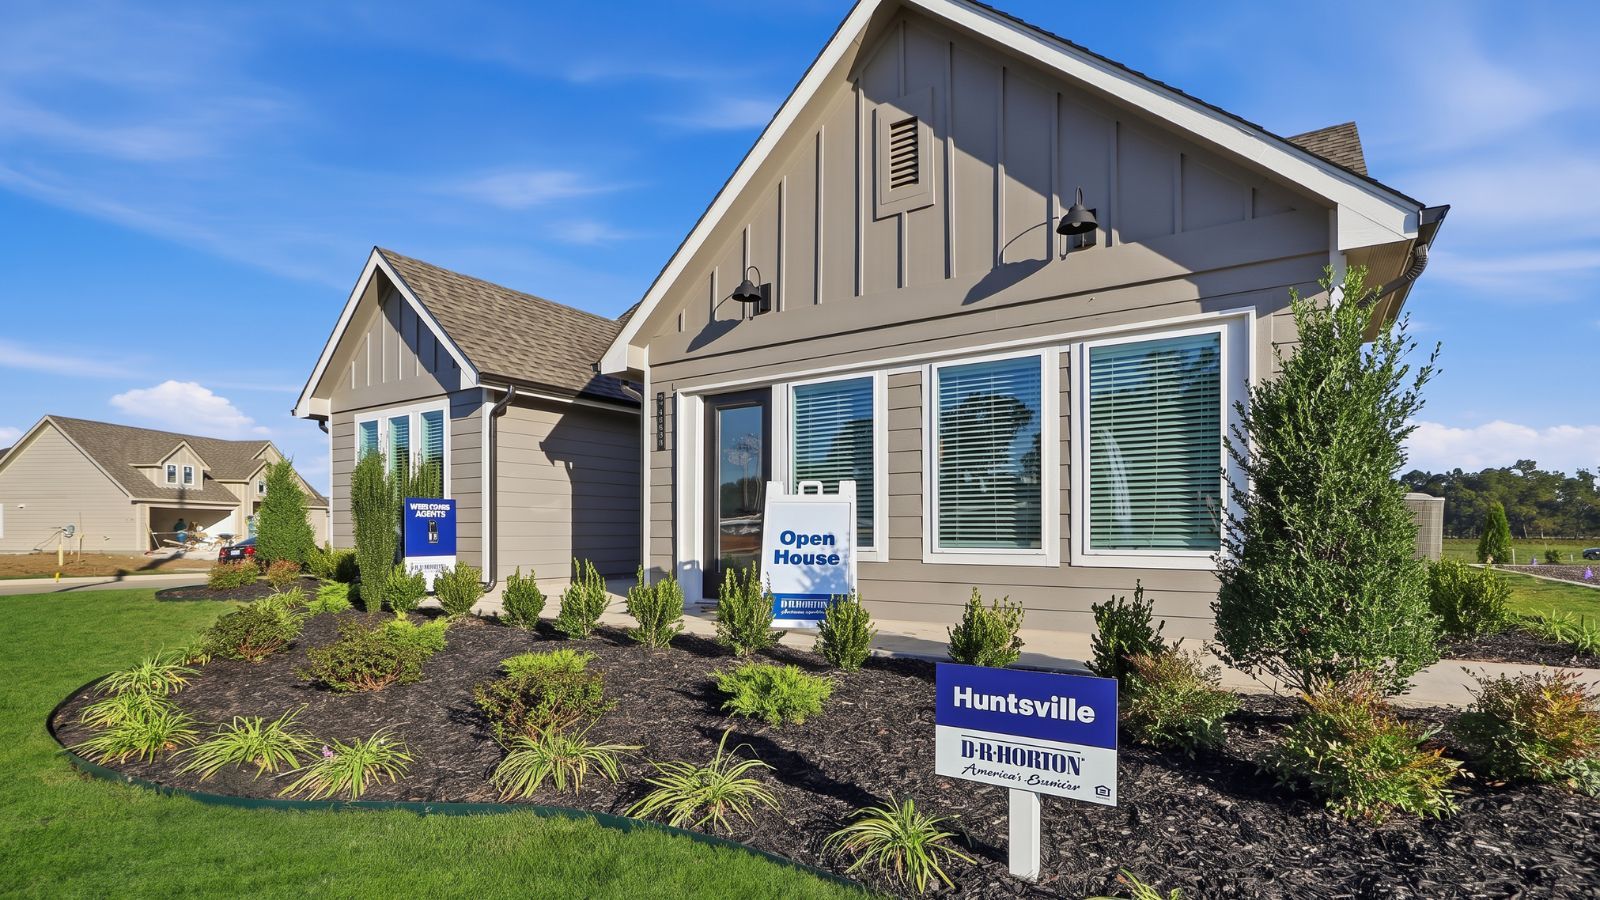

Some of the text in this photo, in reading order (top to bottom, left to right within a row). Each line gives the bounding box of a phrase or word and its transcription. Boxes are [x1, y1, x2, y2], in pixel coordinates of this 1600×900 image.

[780, 530, 835, 548] Open
[774, 549, 840, 565] House
[953, 686, 1096, 724] Huntsville
[961, 763, 1022, 782] America's
